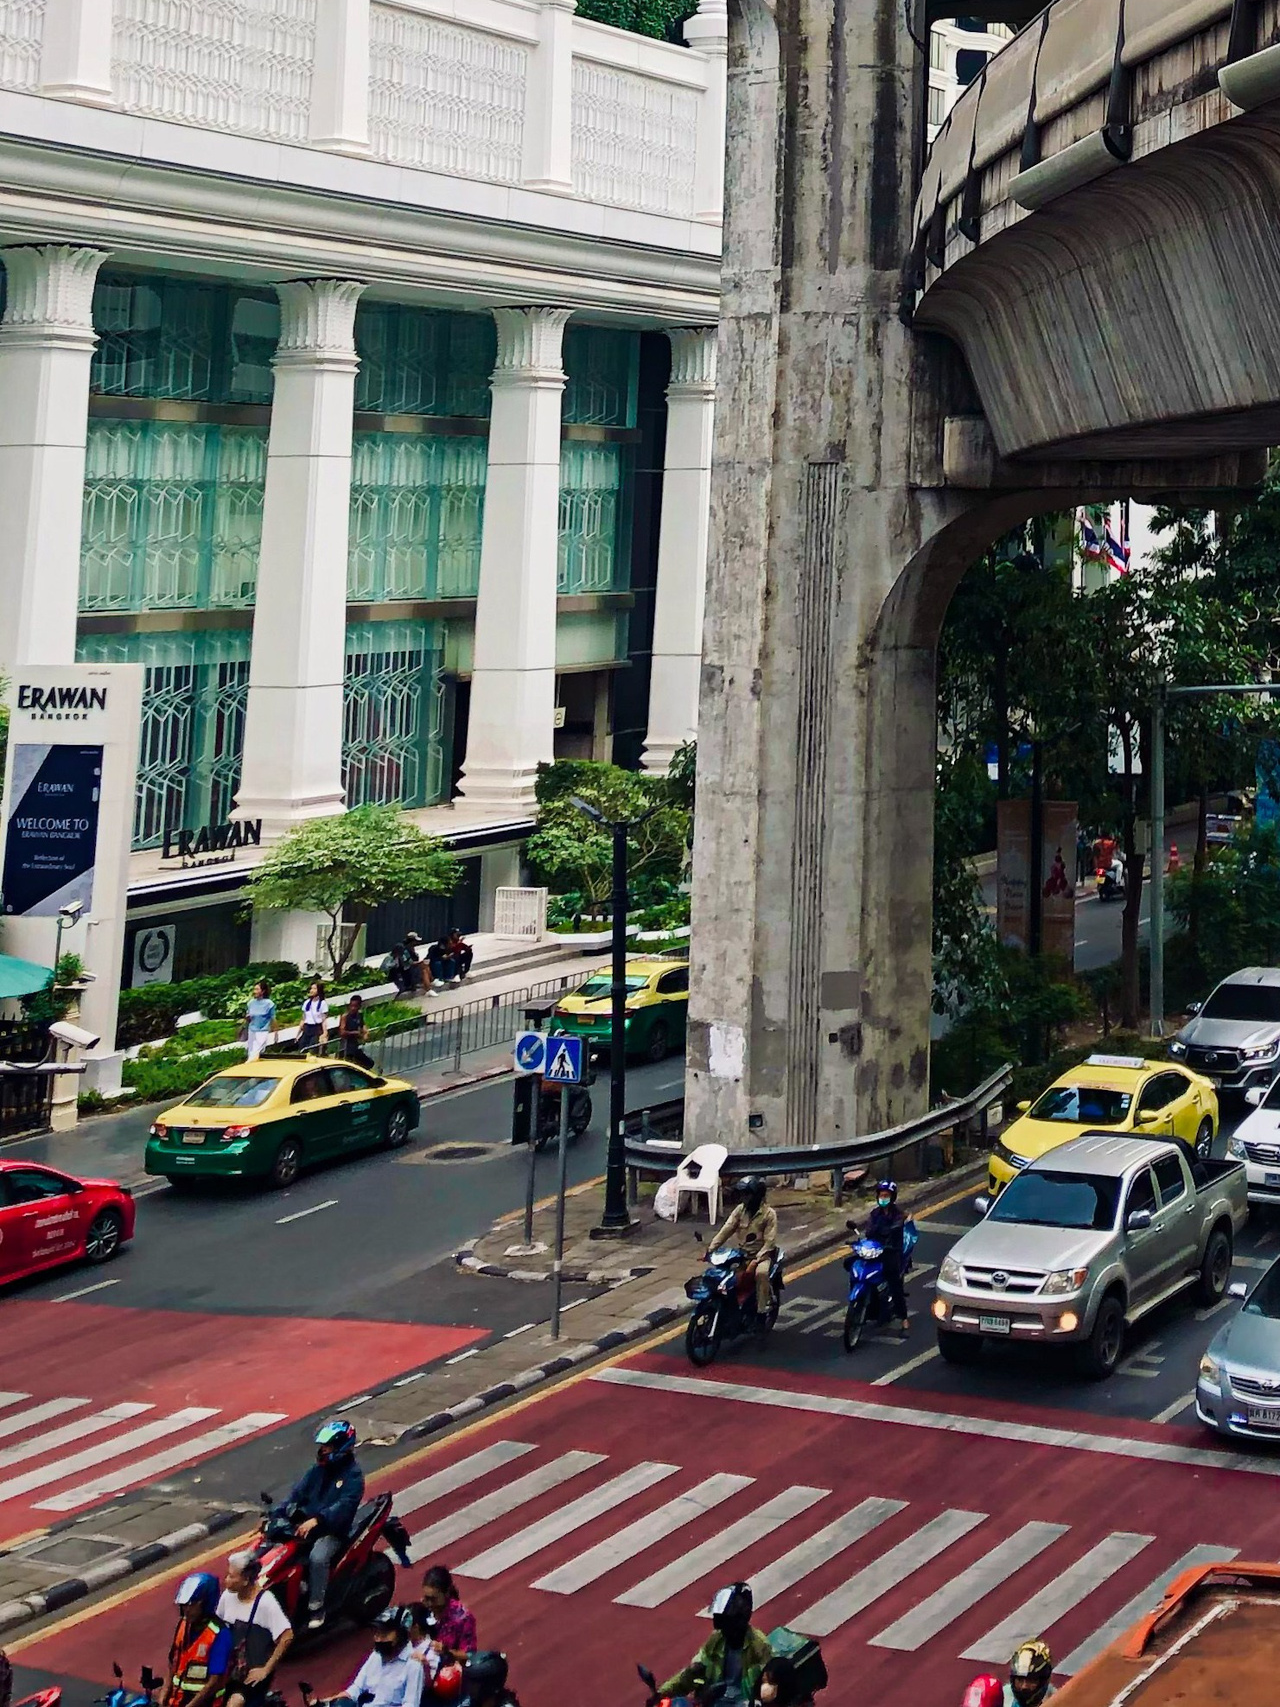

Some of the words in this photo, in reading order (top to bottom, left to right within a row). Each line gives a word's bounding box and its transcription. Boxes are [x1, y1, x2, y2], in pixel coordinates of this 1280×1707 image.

[18, 685, 107, 712] ERAWAN
[31, 713, 88, 721] BANGKOK
[38, 782, 74, 793] ERAWAN
[16, 818, 71, 830] WELCOME
[73, 819, 89, 831] TO
[161, 819, 262, 859] ERAWAN
